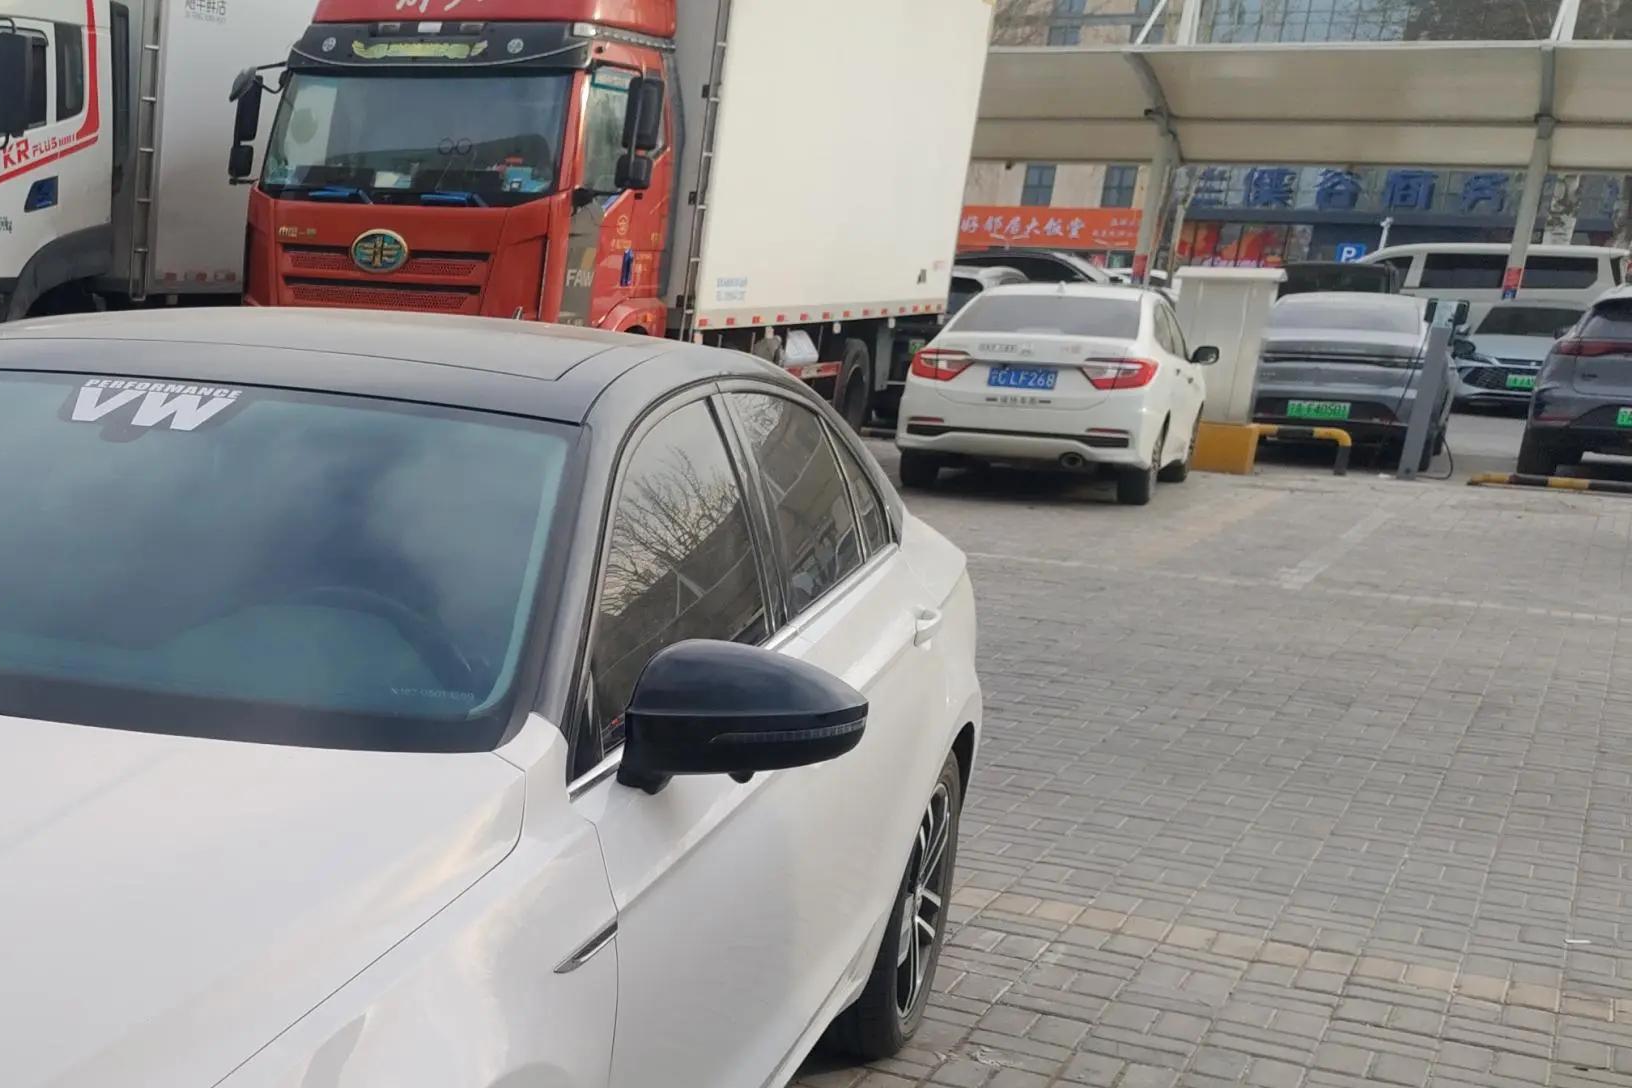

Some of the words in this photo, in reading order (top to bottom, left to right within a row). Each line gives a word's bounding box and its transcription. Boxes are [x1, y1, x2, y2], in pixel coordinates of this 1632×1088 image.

[3, 138, 30, 168] KR
[566, 269, 594, 287] FAW
[84, 379, 243, 399] PERFORMANCE
[71, 386, 237, 431] VW
